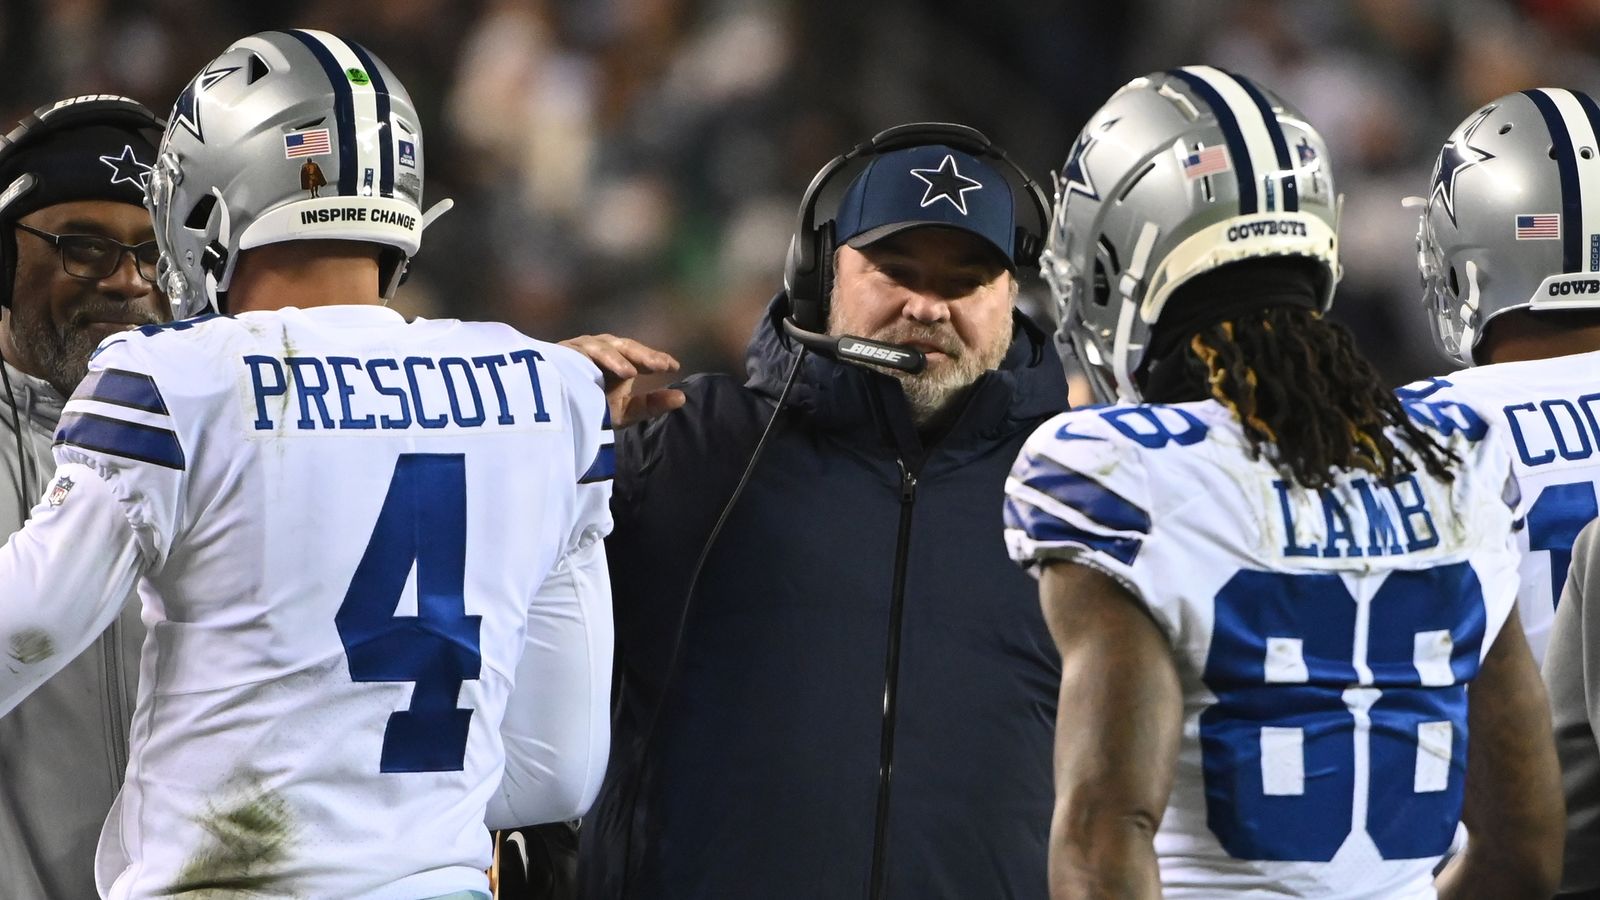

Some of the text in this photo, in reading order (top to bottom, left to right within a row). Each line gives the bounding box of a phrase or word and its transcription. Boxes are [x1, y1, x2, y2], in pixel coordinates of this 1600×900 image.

[301, 207, 416, 231] INSPIRE CHANGE
[243, 349, 551, 431] PRESCOTT
[841, 342, 910, 363] BOSE
[1272, 473, 1440, 558] LAMB
[334, 452, 483, 774] 4
[1200, 561, 1486, 861] 88
